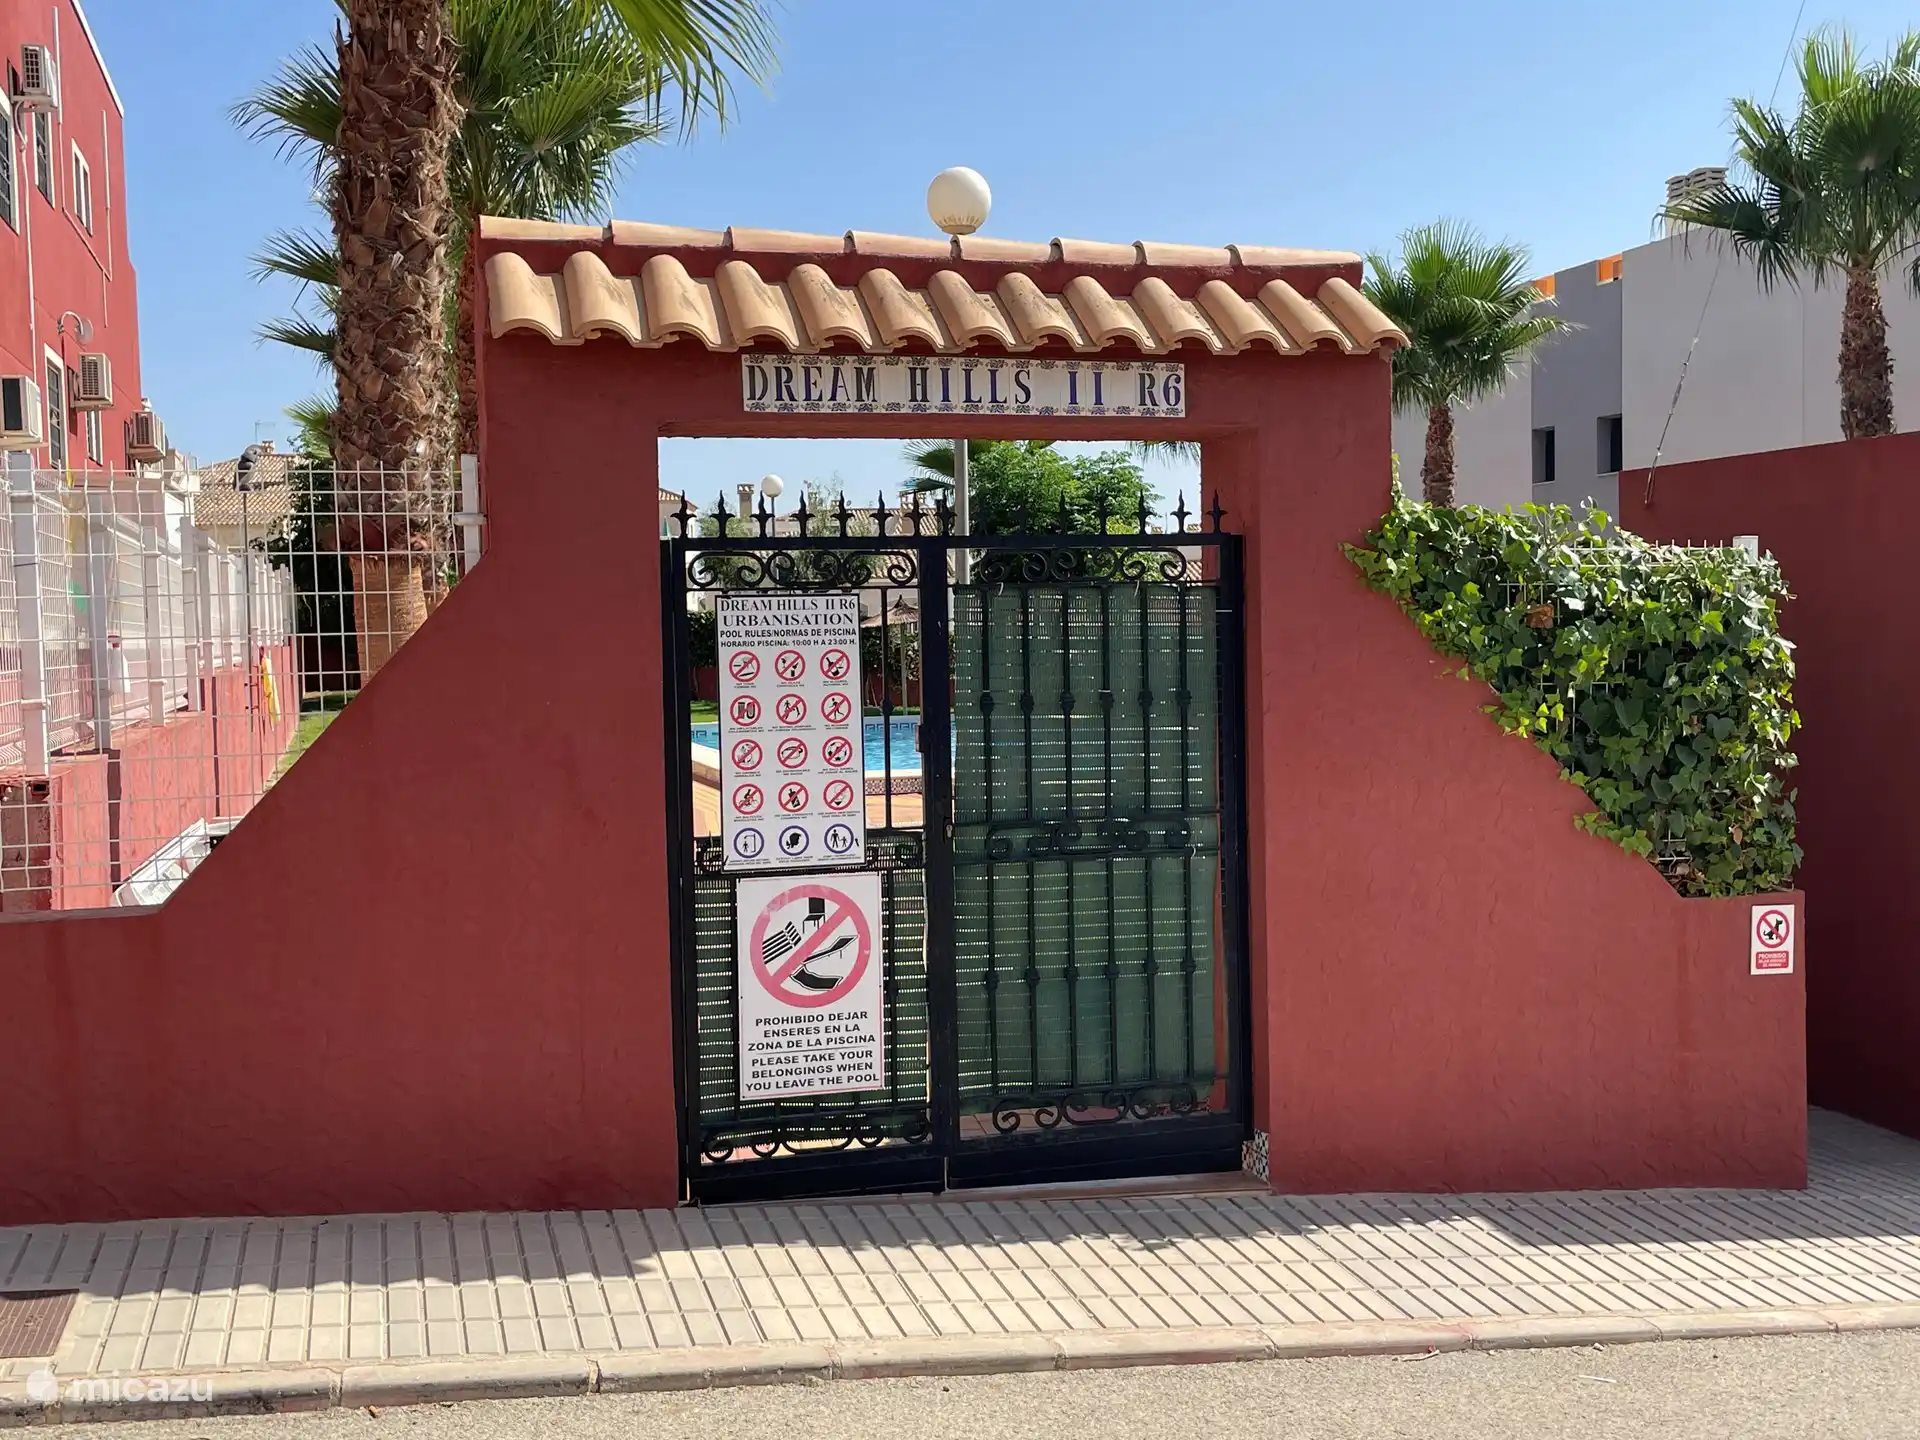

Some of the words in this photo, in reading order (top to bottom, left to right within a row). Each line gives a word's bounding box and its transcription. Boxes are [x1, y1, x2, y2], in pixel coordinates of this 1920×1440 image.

[746, 364, 878, 403] DREAM
[907, 366, 1032, 405] HILLS
[1067, 371, 1104, 406] II
[1138, 370, 1182, 407] R6
[720, 599, 772, 612] DREAM
[777, 599, 818, 611] HILLS
[825, 599, 836, 610] II
[839, 598, 856, 610] R6
[723, 613, 854, 627] URBANISATION
[720, 630, 742, 638] POOL
[745, 629, 809, 638] RULES/NORMAS
[811, 628, 821, 636] DE
[823, 628, 857, 636] PISCINA
[720, 640, 755, 648] HORARIO
[757, 639, 790, 647] PISCINA:
[791, 639, 812, 647] 10:00
[755, 1014, 824, 1027] PROHIBIDO
[828, 1011, 868, 1022] DEJAR
[763, 1026, 821, 1038] ENSERES
[824, 1025, 841, 1034] EN
[845, 1023, 860, 1032] LA
[748, 1041, 783, 1052] ZONA
[786, 1039, 803, 1049] DE
[806, 1038, 822, 1047] LA
[826, 1034, 876, 1046] PISCINA
[752, 1055, 799, 1067] PLEASE
[803, 1052, 835, 1063] TAKE
[839, 1050, 873, 1061] YOUR
[752, 1064, 833, 1079] BELONGINGS
[836, 1062, 873, 1072] WHEN
[745, 1081, 771, 1092] YOU
[775, 1078, 815, 1089] LEAVE
[818, 1075, 843, 1086] THE
[847, 1073, 880, 1084] POOL
